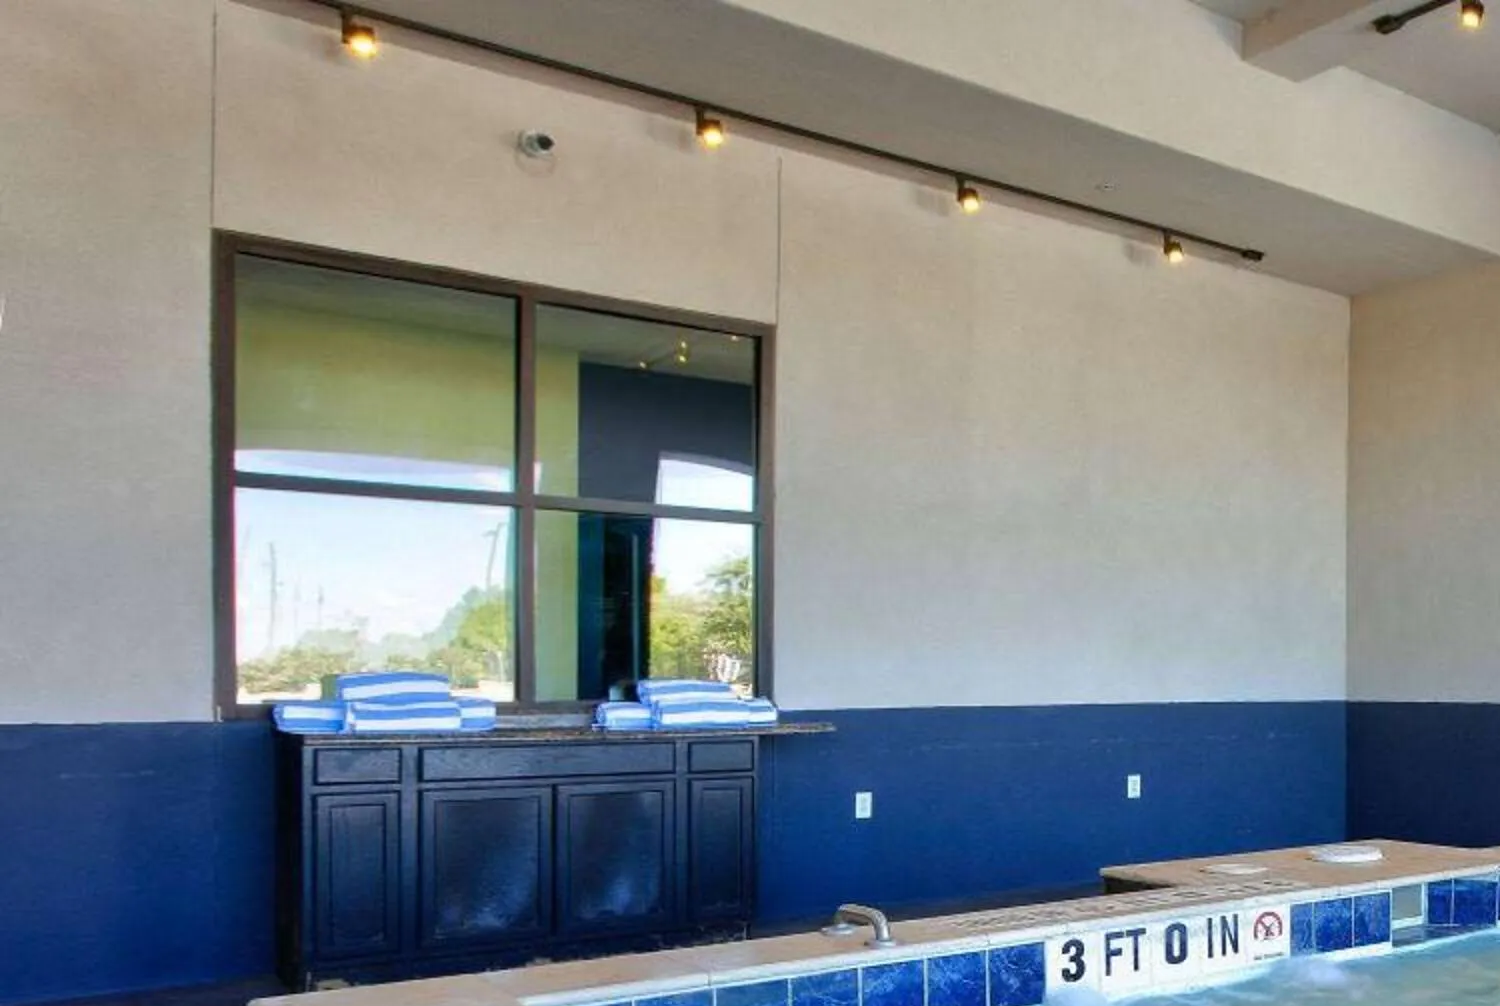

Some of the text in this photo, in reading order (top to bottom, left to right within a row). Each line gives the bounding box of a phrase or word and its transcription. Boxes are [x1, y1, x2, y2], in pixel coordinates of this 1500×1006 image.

[1061, 939, 1085, 982] 3
[1105, 928, 1146, 976] FT
[1207, 913, 1239, 958] IN
